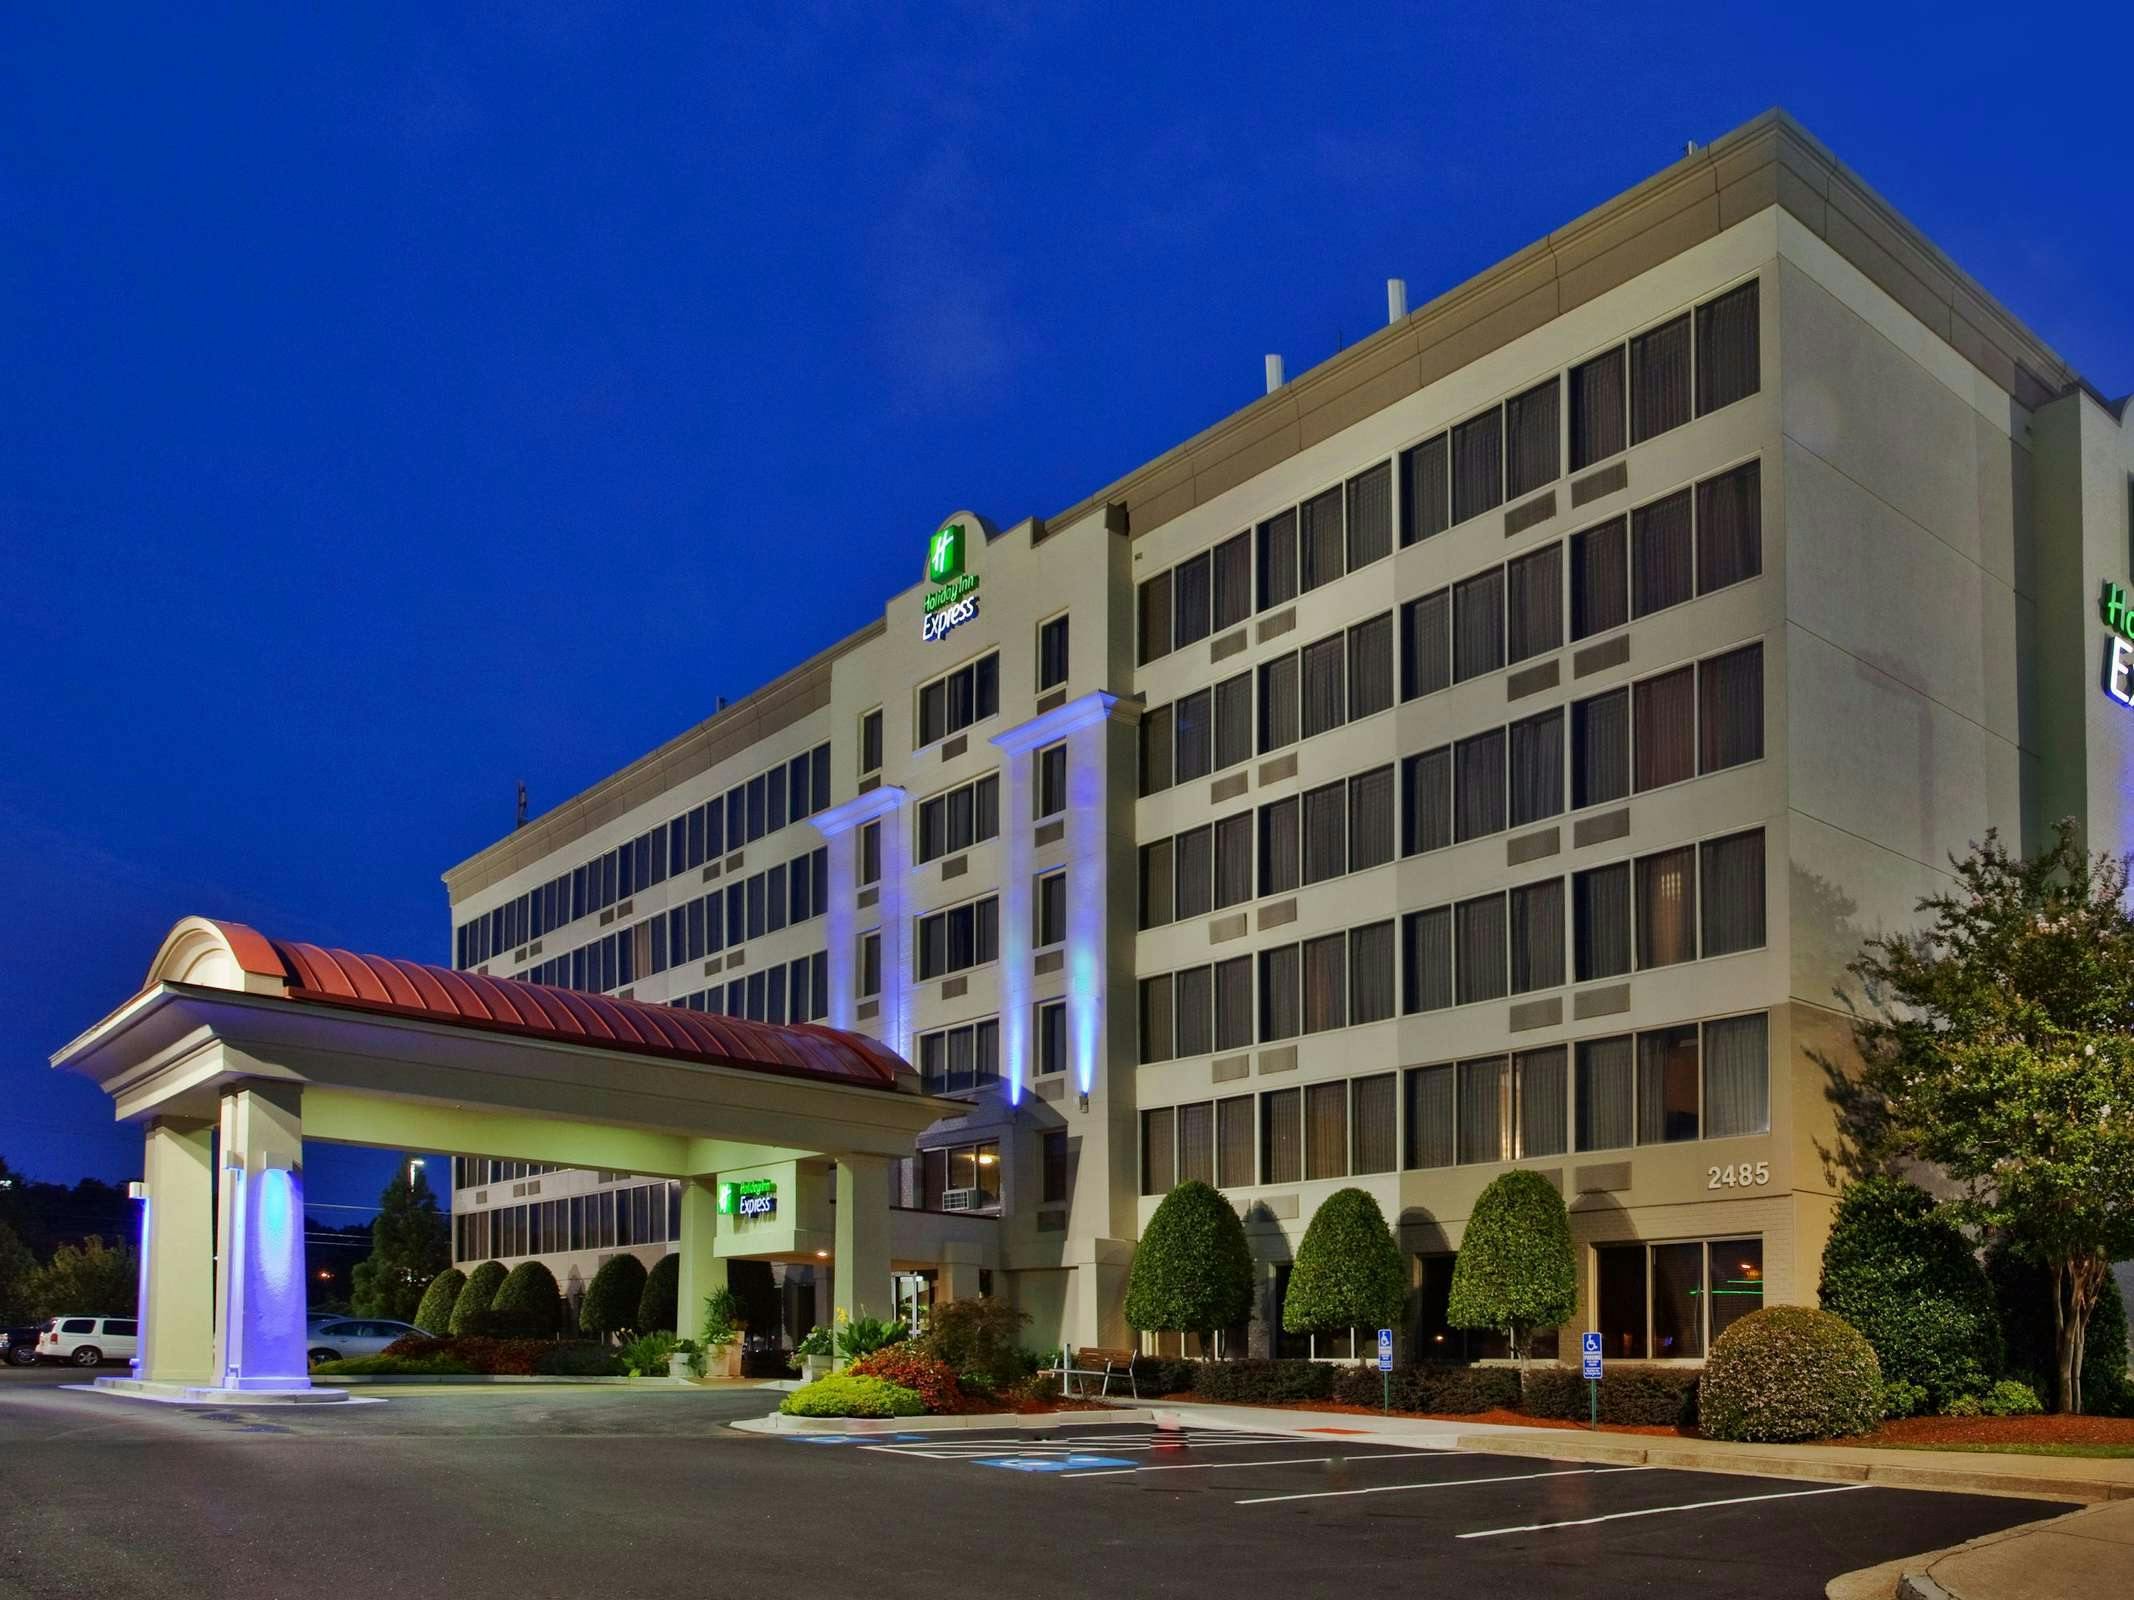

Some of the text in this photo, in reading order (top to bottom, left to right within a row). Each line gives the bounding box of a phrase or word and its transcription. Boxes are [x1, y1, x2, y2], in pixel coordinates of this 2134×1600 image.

[924, 575, 976, 612] Holiday Inn
[922, 596, 976, 640] Express
[1708, 1161, 1769, 1189] 2485
[740, 1195, 772, 1219] Express
